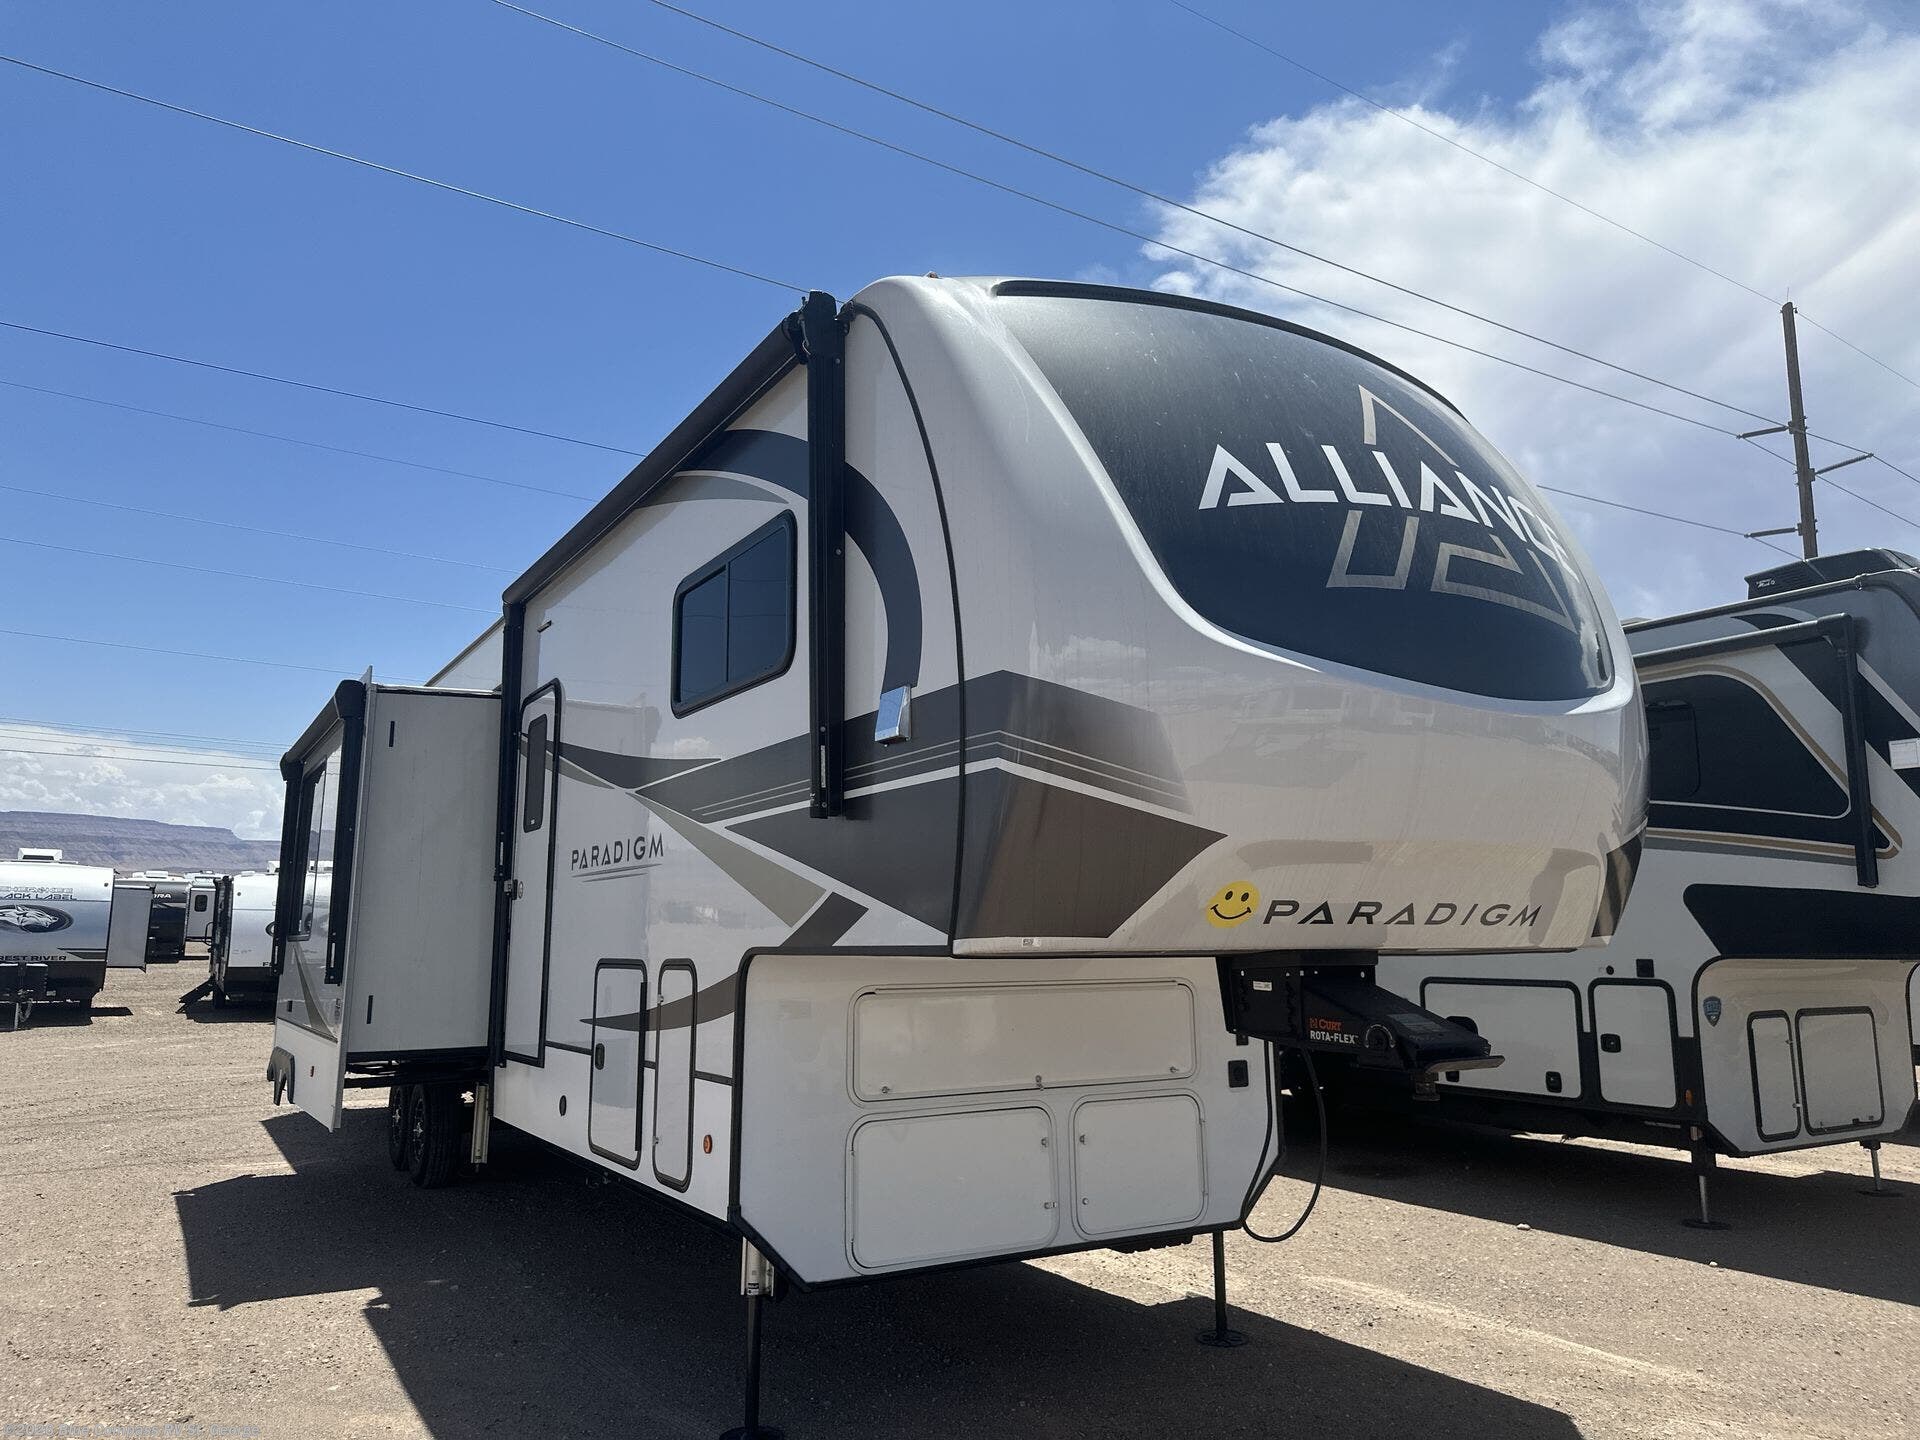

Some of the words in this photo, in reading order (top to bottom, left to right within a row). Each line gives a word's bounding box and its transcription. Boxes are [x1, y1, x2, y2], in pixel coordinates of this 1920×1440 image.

[1199, 442, 1581, 583] ALLIANCE
[571, 832, 664, 871] PARADIGM
[36, 893, 77, 901] LABEL
[1263, 899, 1542, 927] PARADIGM
[1318, 1018, 1342, 1031] CURT
